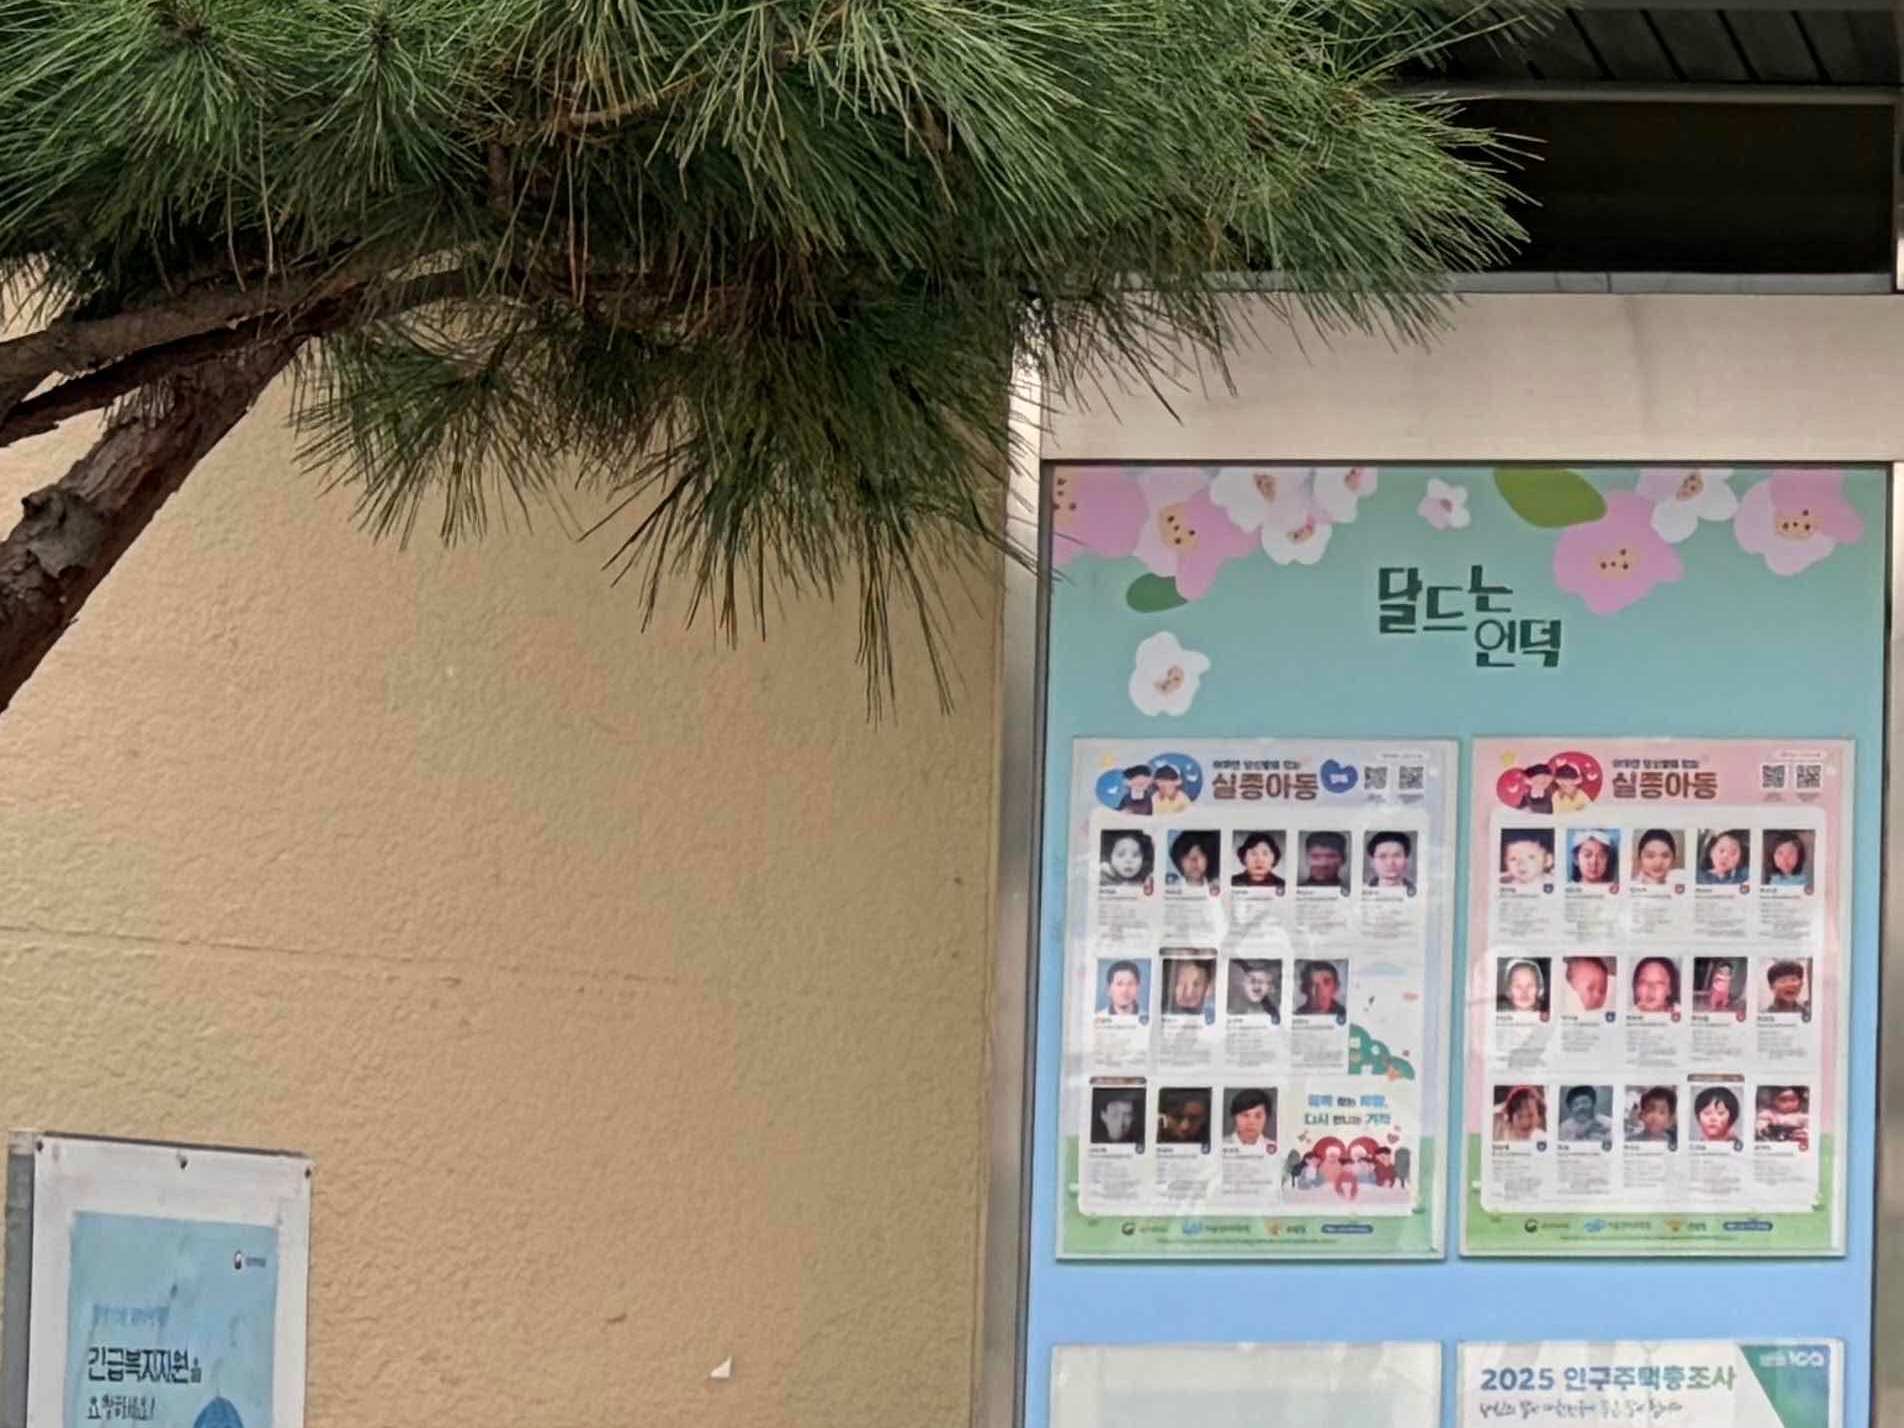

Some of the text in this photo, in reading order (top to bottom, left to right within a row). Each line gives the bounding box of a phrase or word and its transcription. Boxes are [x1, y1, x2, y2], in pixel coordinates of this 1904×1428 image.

[1474, 619, 1562, 668] 언덕
[1211, 772, 1320, 801] 실종아동
[1611, 772, 1718, 800] 실종아동
[1479, 1367, 1554, 1391] 2025
